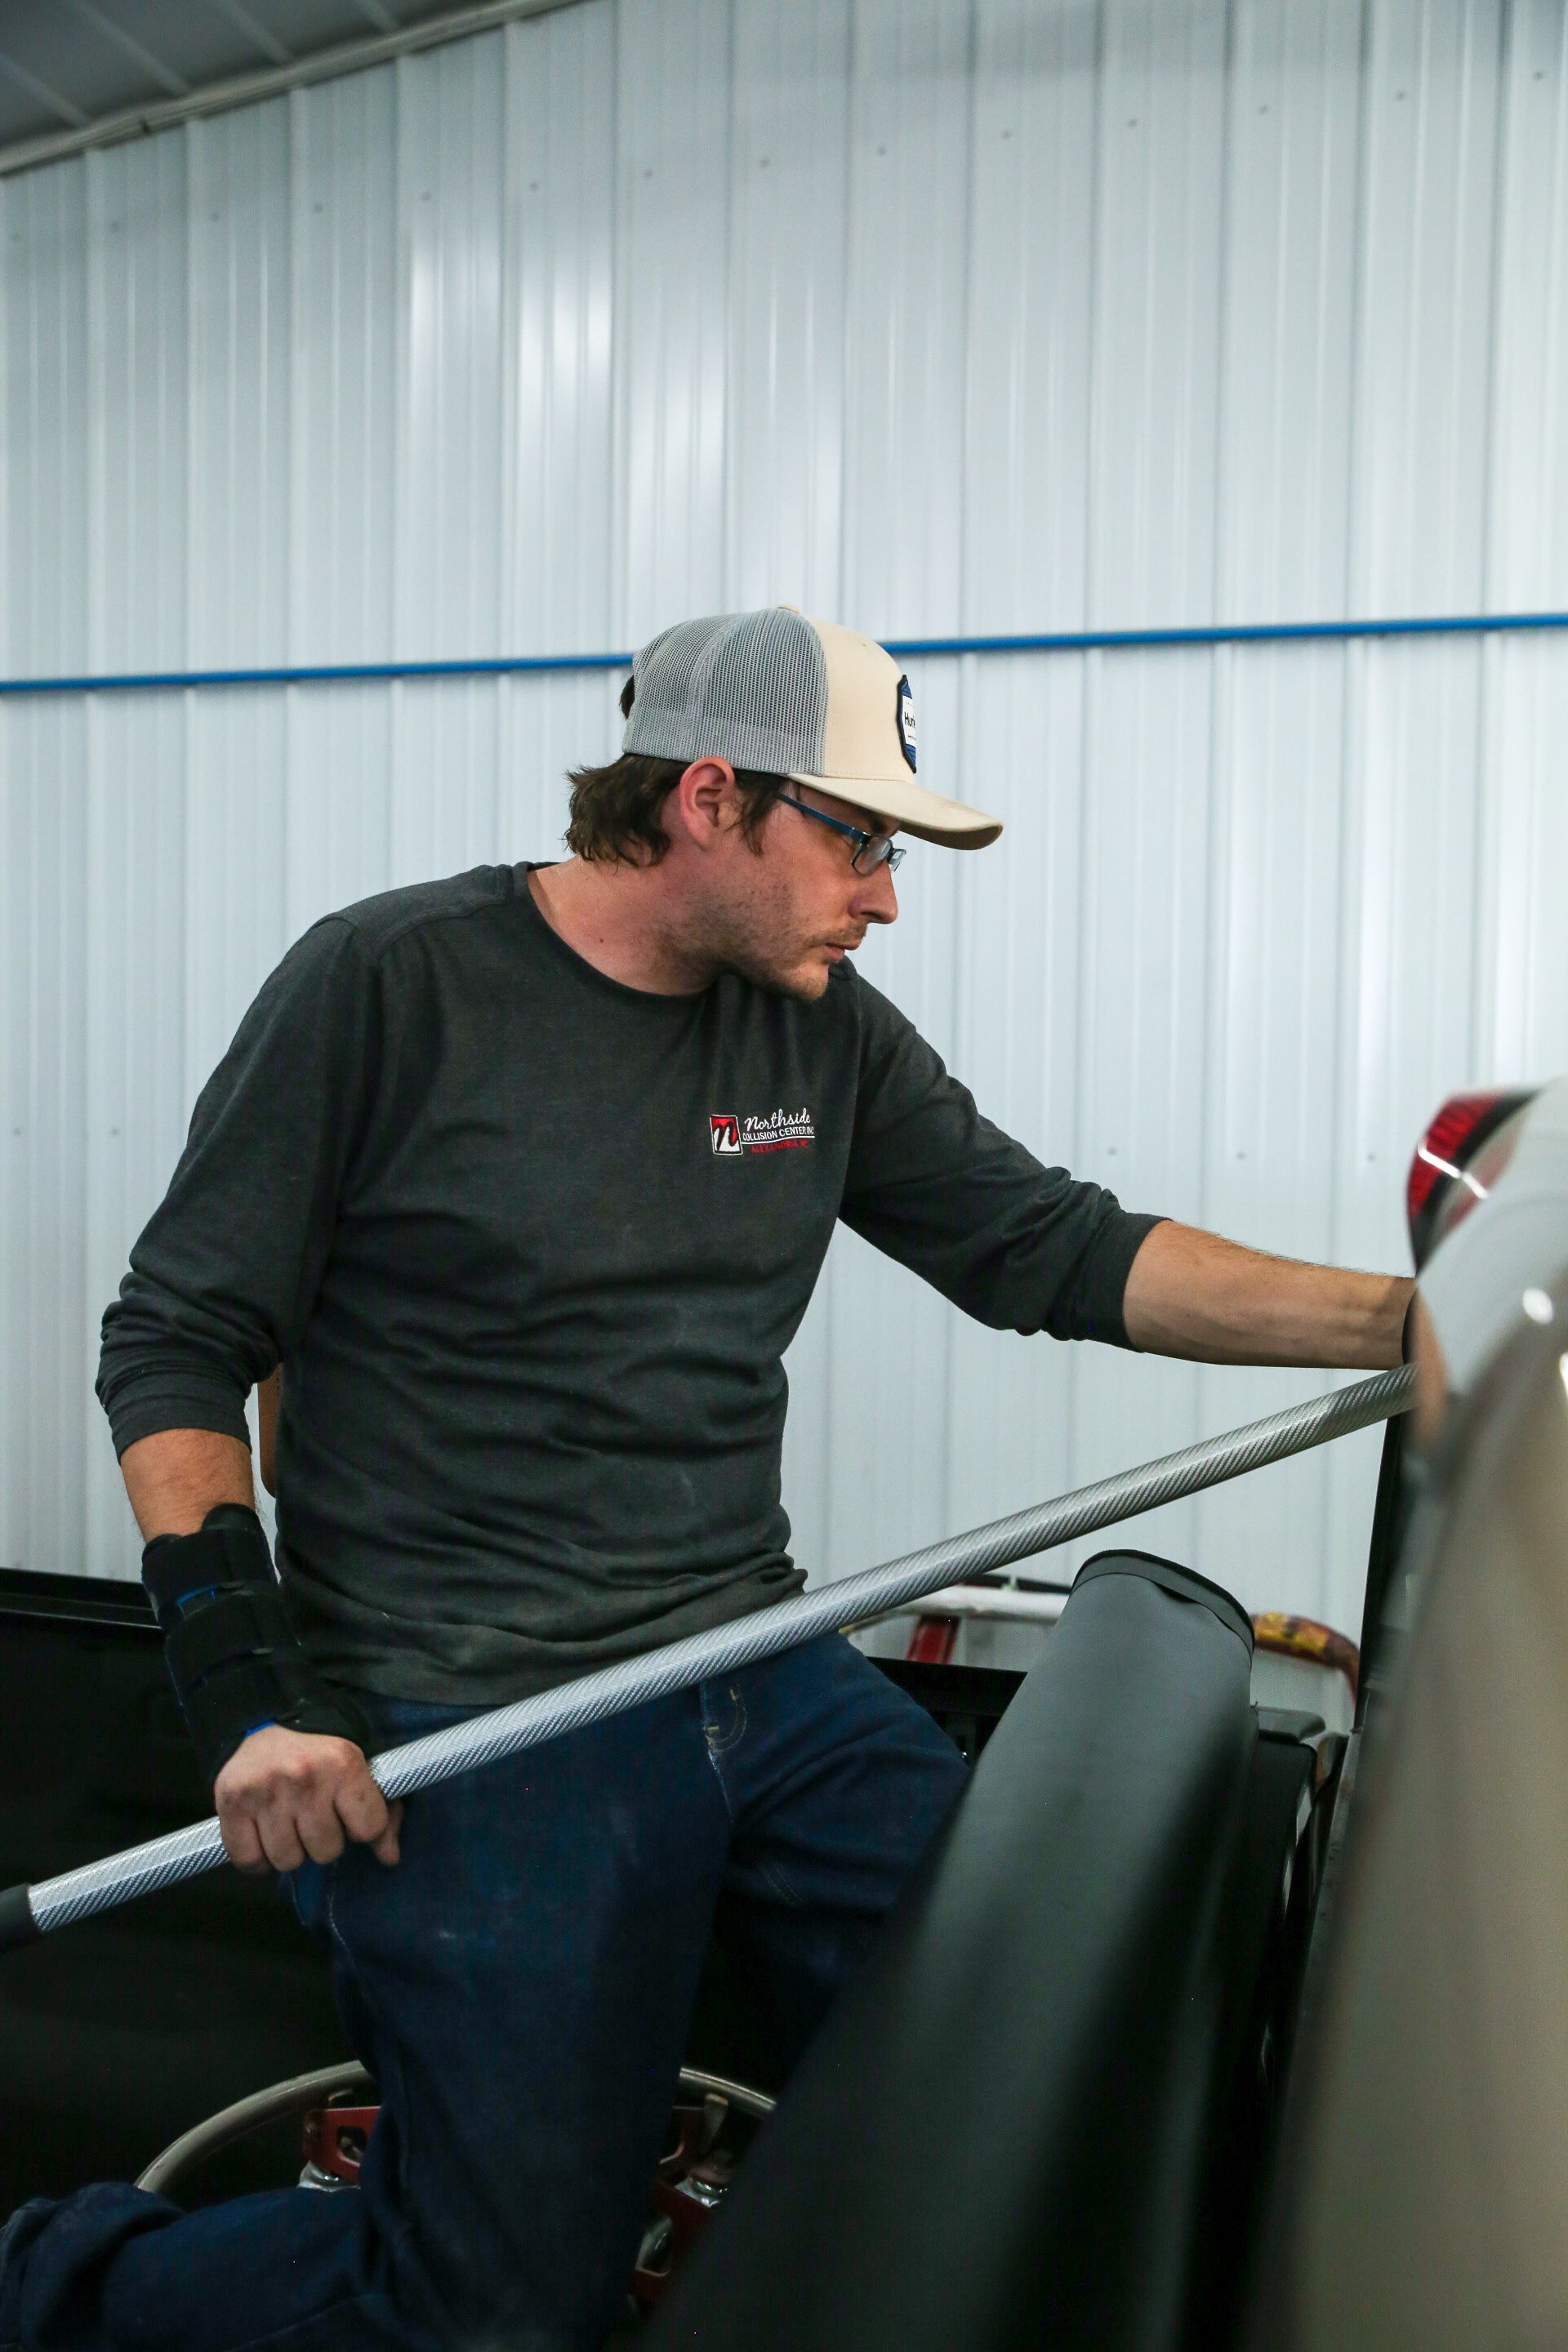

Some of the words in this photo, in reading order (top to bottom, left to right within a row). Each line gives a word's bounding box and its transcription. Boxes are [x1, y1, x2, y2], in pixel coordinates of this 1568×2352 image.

[745, 1107, 811, 1132] Northside
[742, 1130, 778, 1142] COLLISION
[778, 1126, 806, 1137] CENTER
